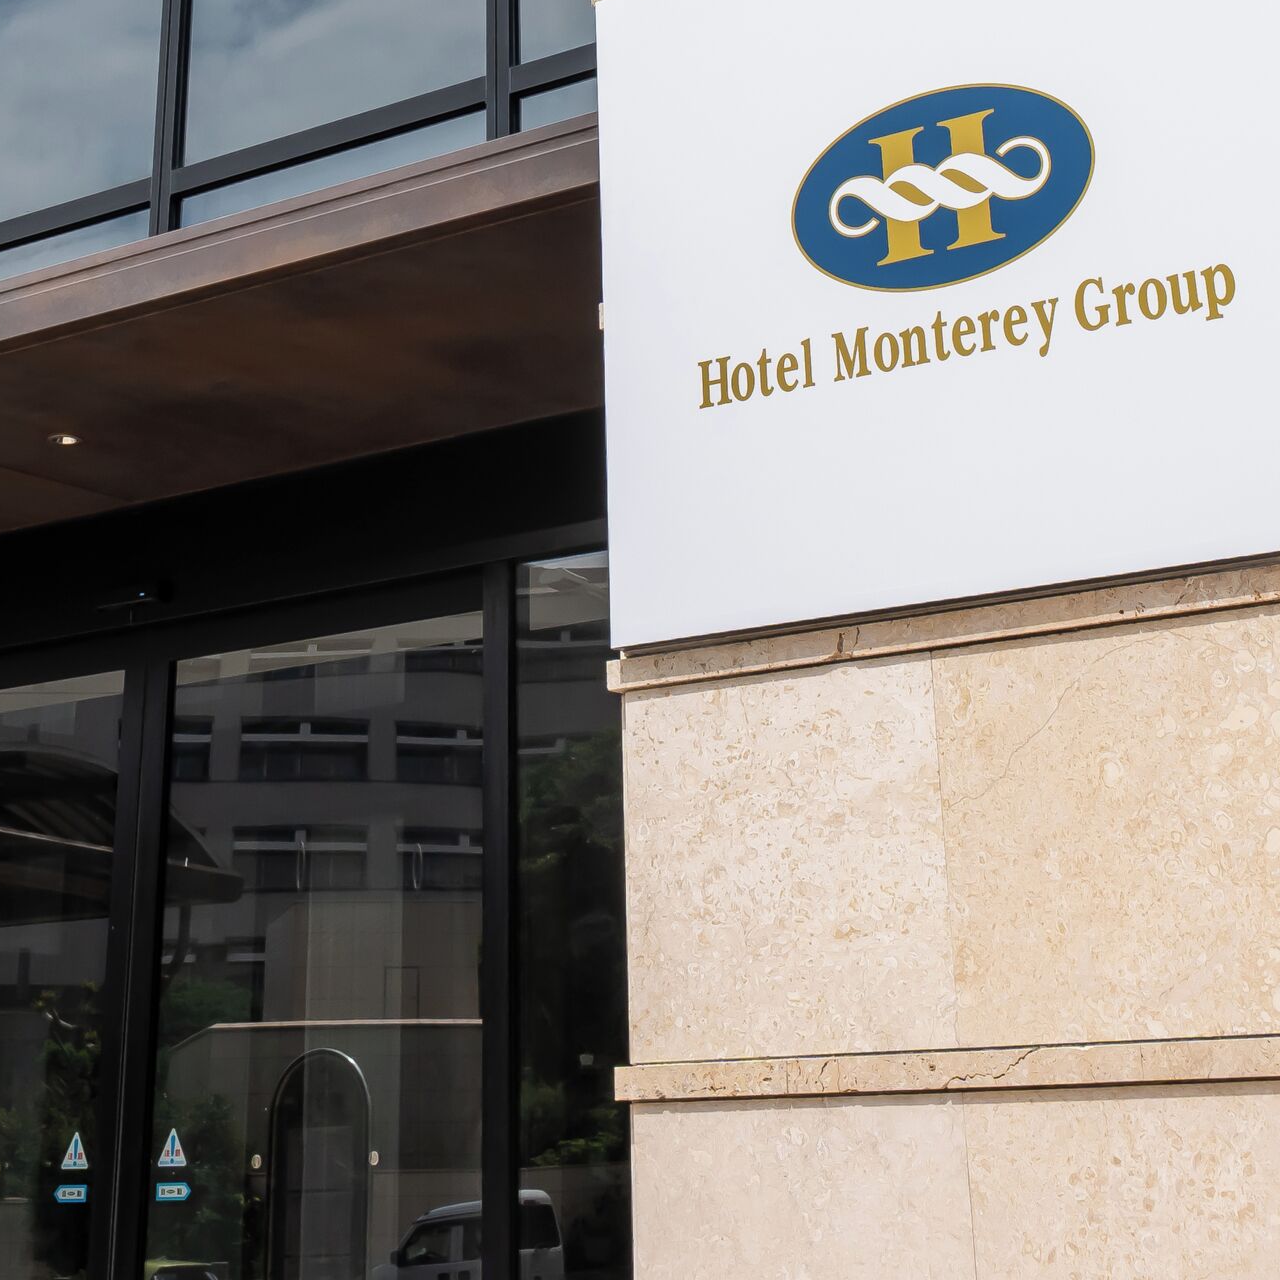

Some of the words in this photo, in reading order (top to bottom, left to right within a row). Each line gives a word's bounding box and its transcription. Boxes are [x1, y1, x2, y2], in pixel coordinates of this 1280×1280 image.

[697, 337, 816, 410] Hotel
[831, 297, 1059, 383] Monterey
[1074, 263, 1236, 332] Group
